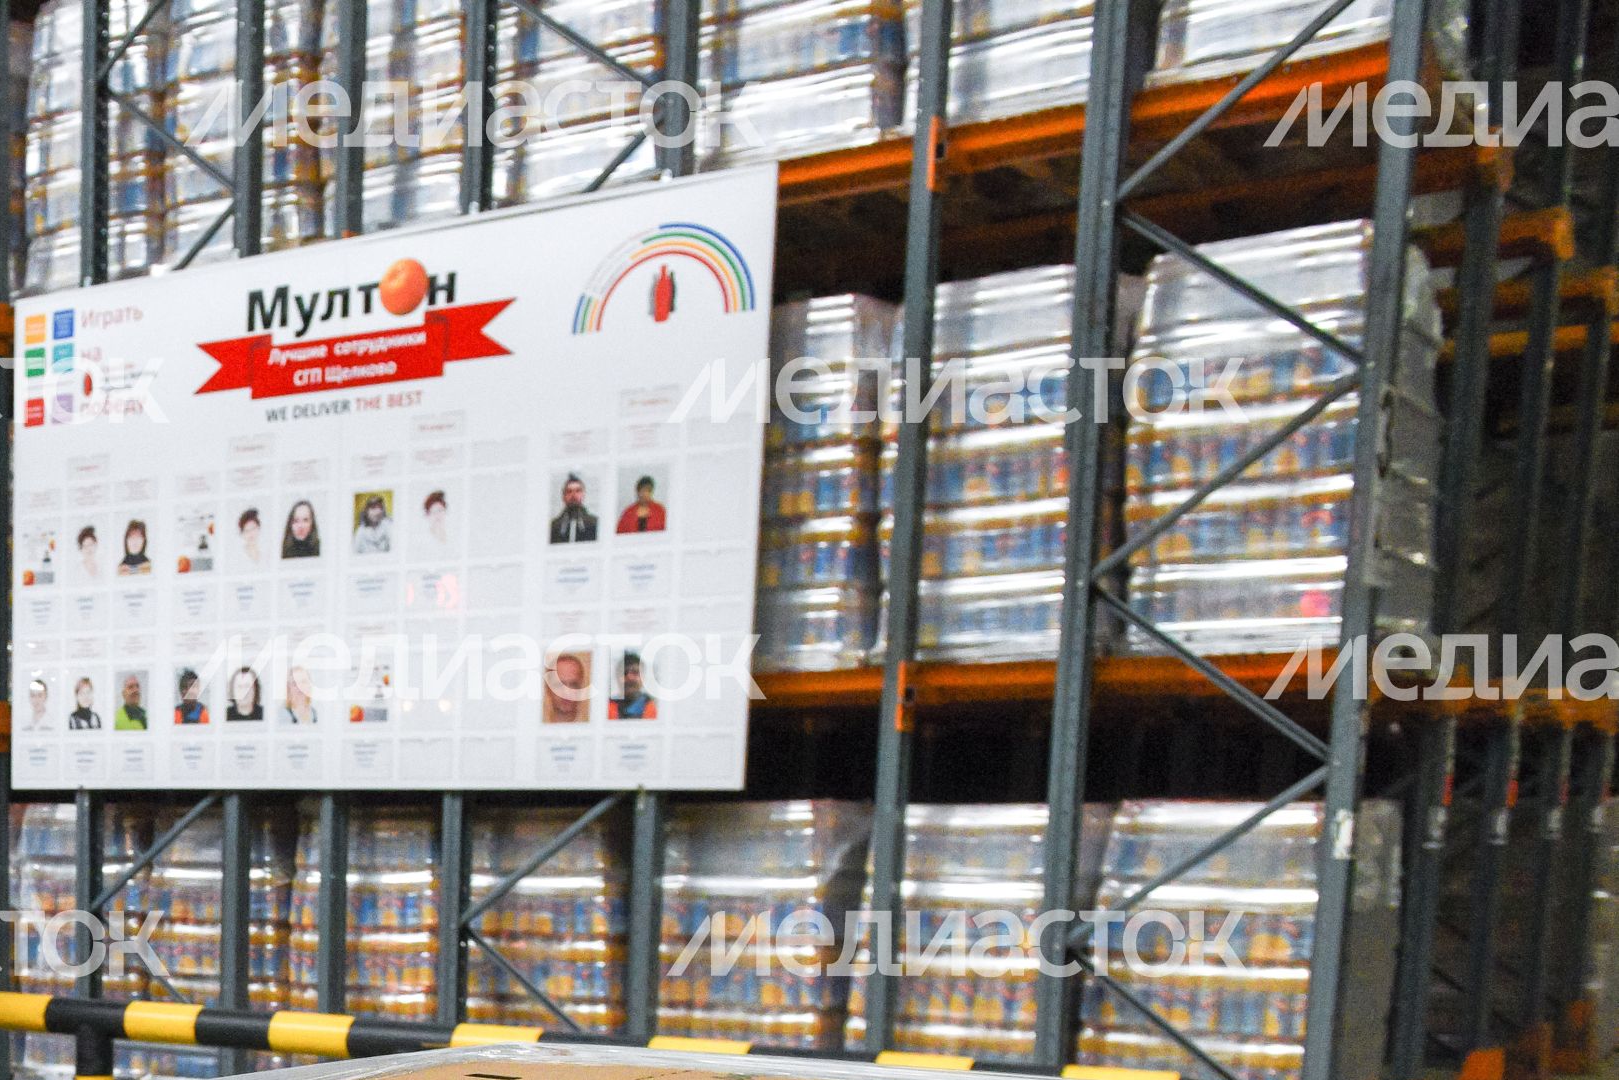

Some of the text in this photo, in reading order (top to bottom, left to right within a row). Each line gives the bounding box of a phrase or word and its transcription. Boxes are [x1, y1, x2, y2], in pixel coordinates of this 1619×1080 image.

[265, 390, 424, 424] WE DELIVER THE BEST
